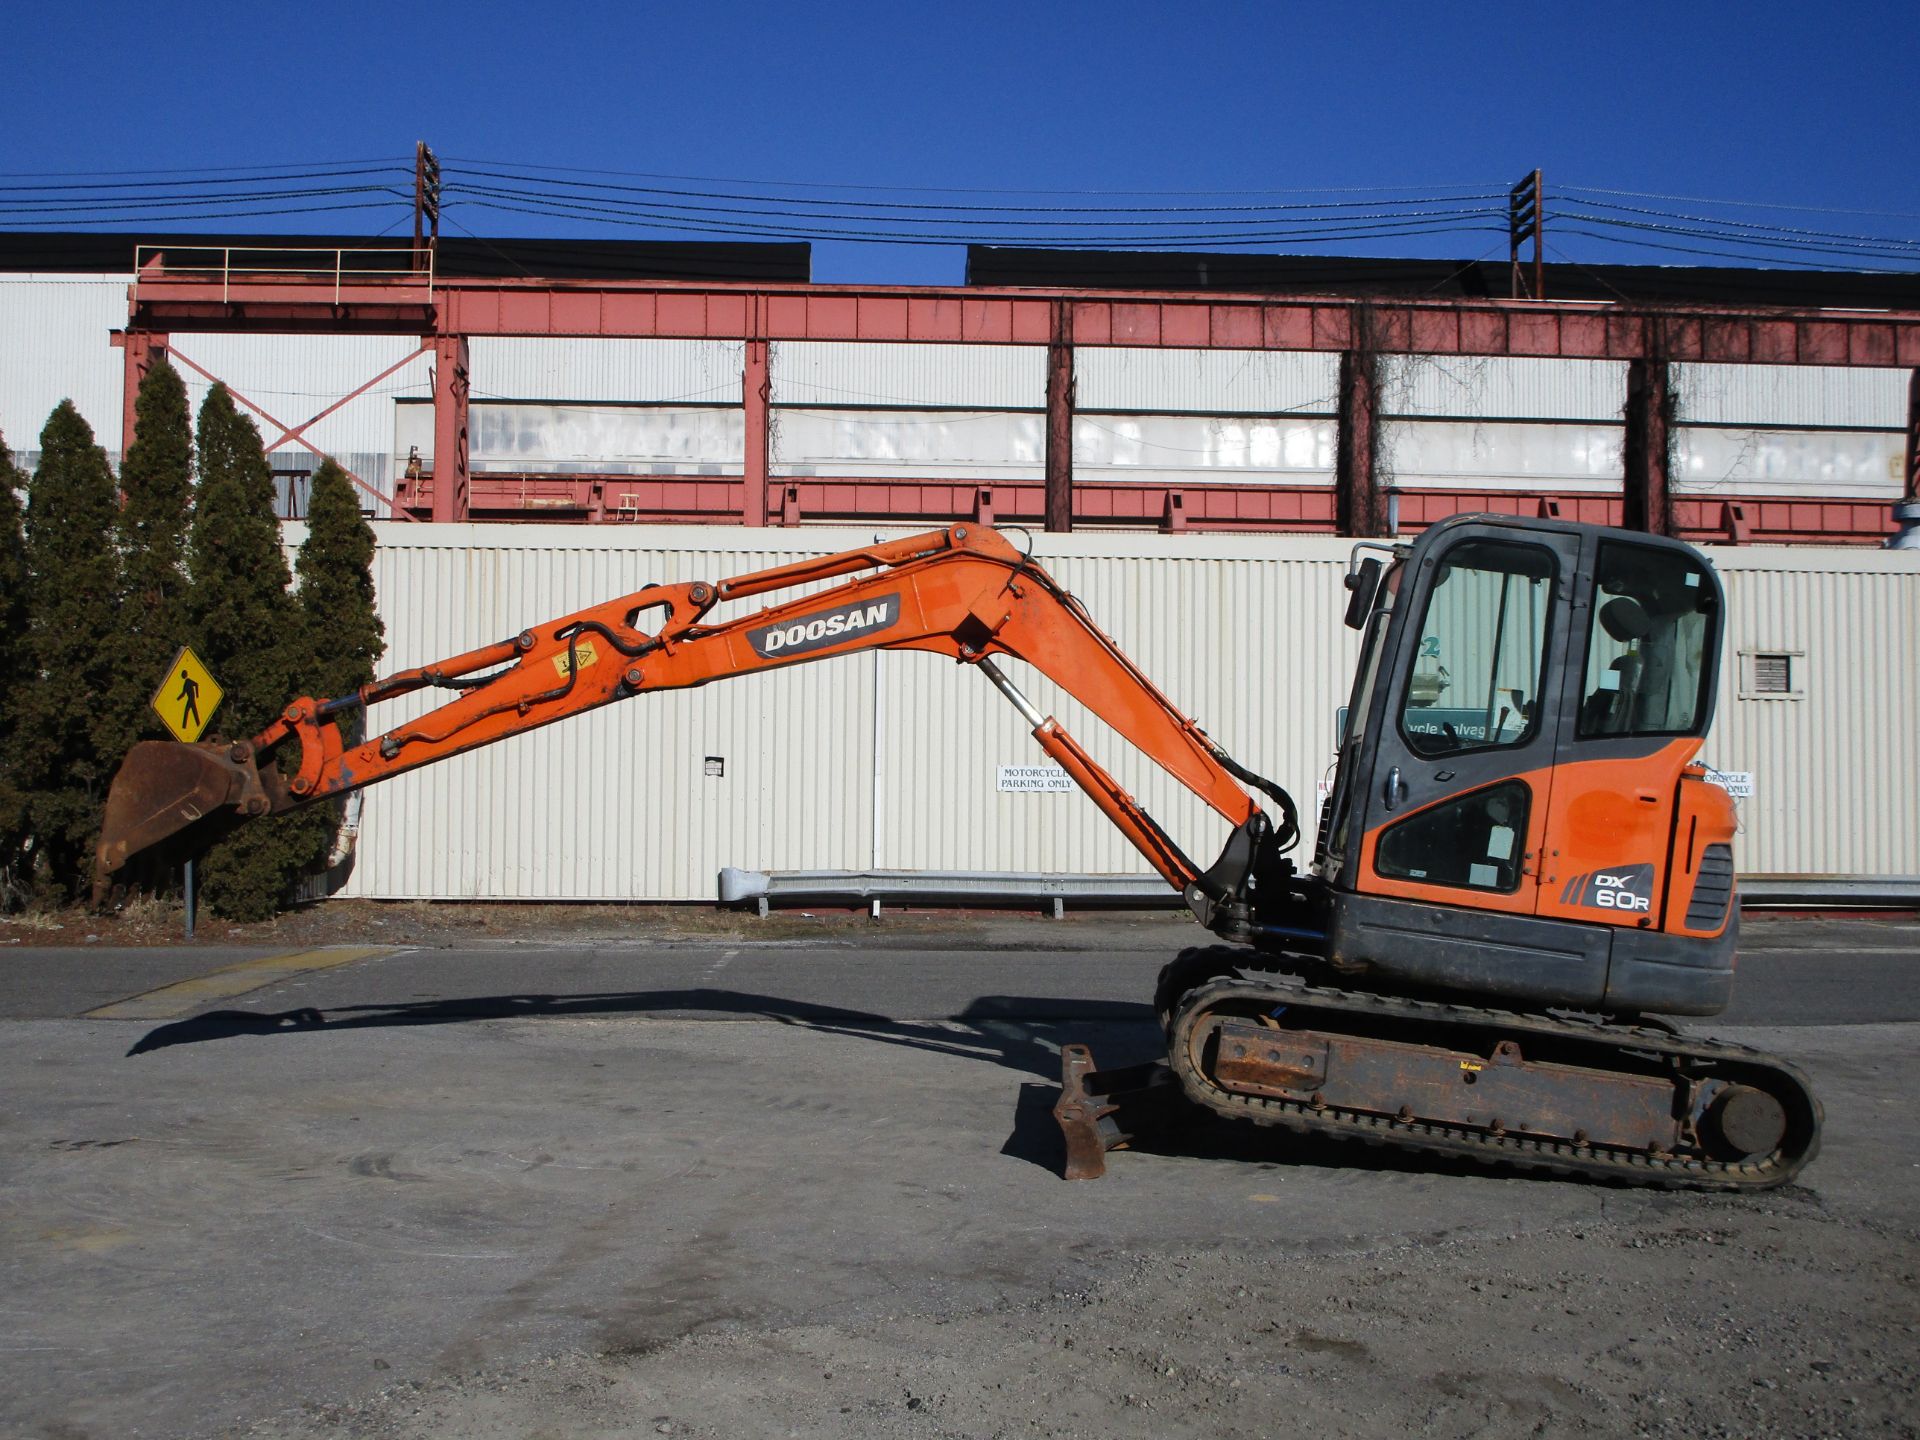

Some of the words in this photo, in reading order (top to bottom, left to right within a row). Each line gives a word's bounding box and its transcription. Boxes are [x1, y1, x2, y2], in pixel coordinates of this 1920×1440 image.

[765, 603, 888, 652] DOOSAN
[1423, 636, 1441, 656] 2
[1004, 769, 1069, 777] MOTORCYCLE
[1001, 779, 1044, 788] PARKING
[1048, 779, 1072, 788] ONLY
[1594, 874, 1635, 889] DX
[1596, 889, 1650, 911] 60R
